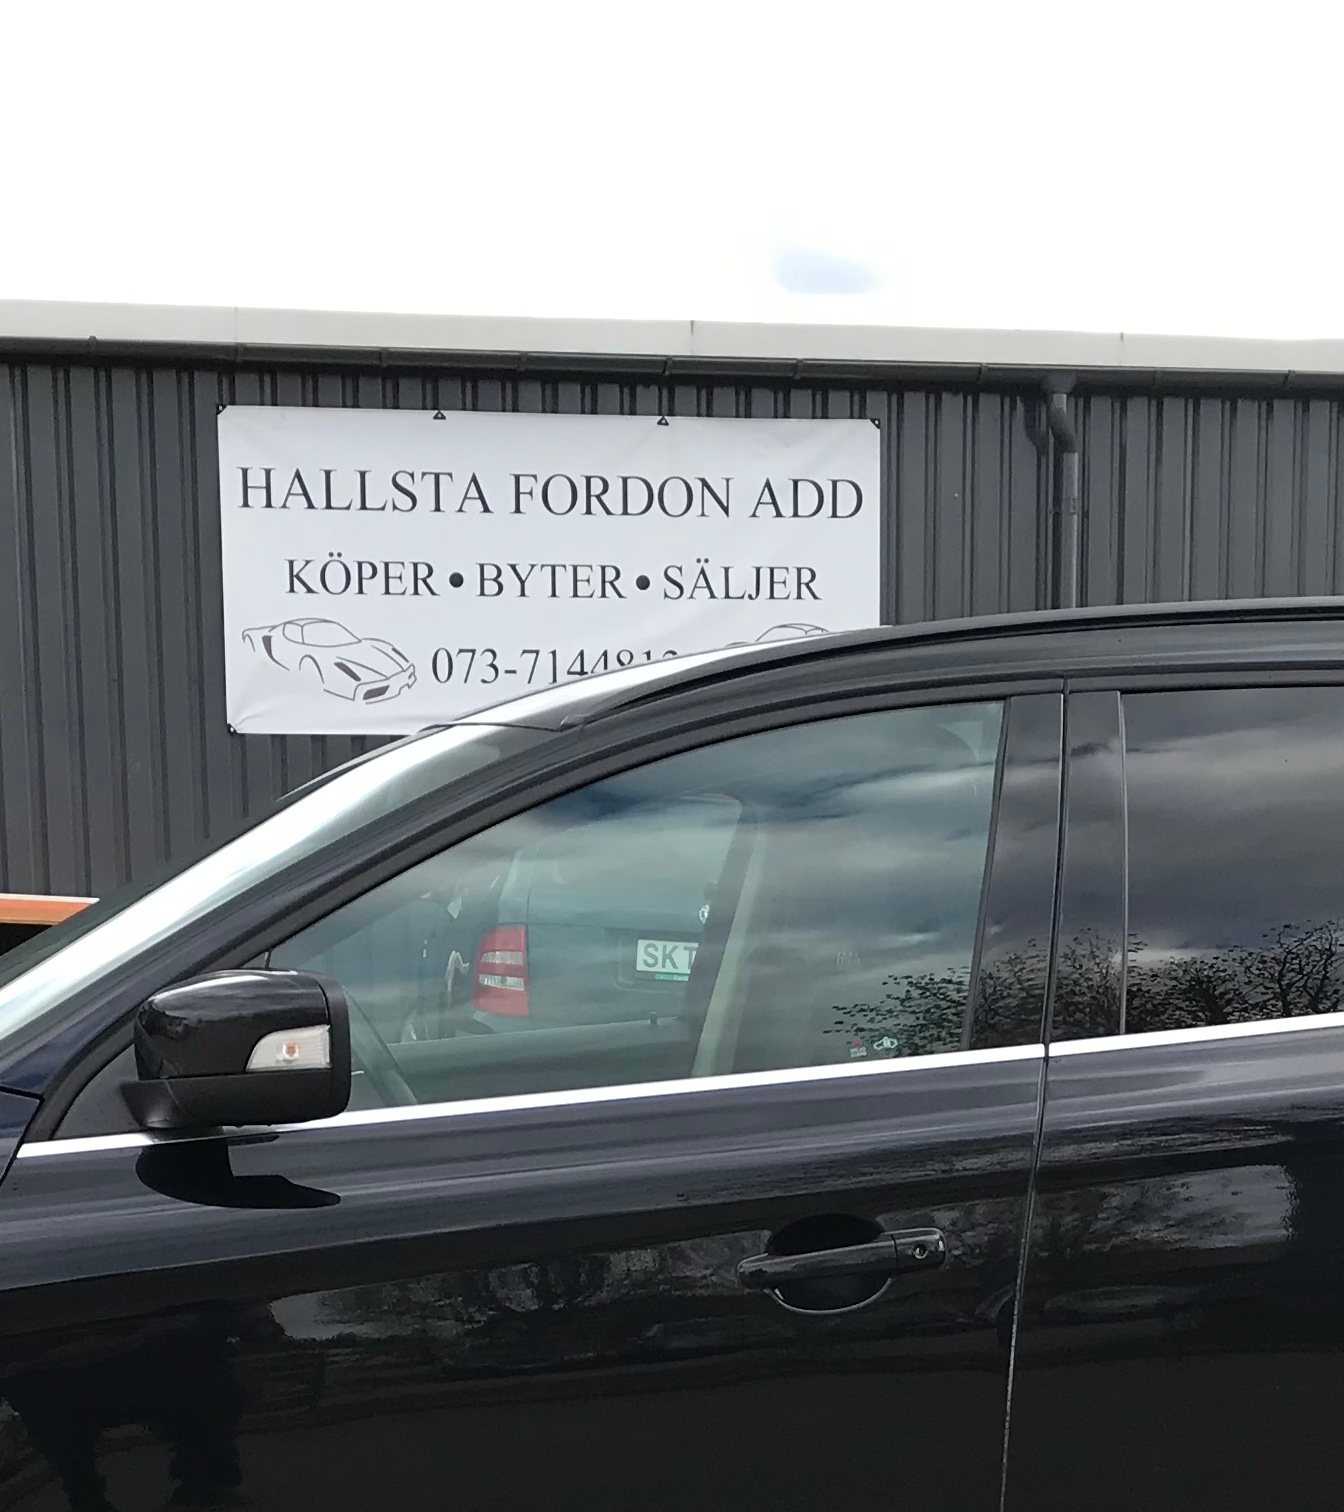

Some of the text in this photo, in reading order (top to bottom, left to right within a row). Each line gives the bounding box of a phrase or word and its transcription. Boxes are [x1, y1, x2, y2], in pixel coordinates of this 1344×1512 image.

[238, 467, 864, 519] HALLSTA FORDON ADD
[286, 551, 821, 602] KÖPER BYTER SÄLJER
